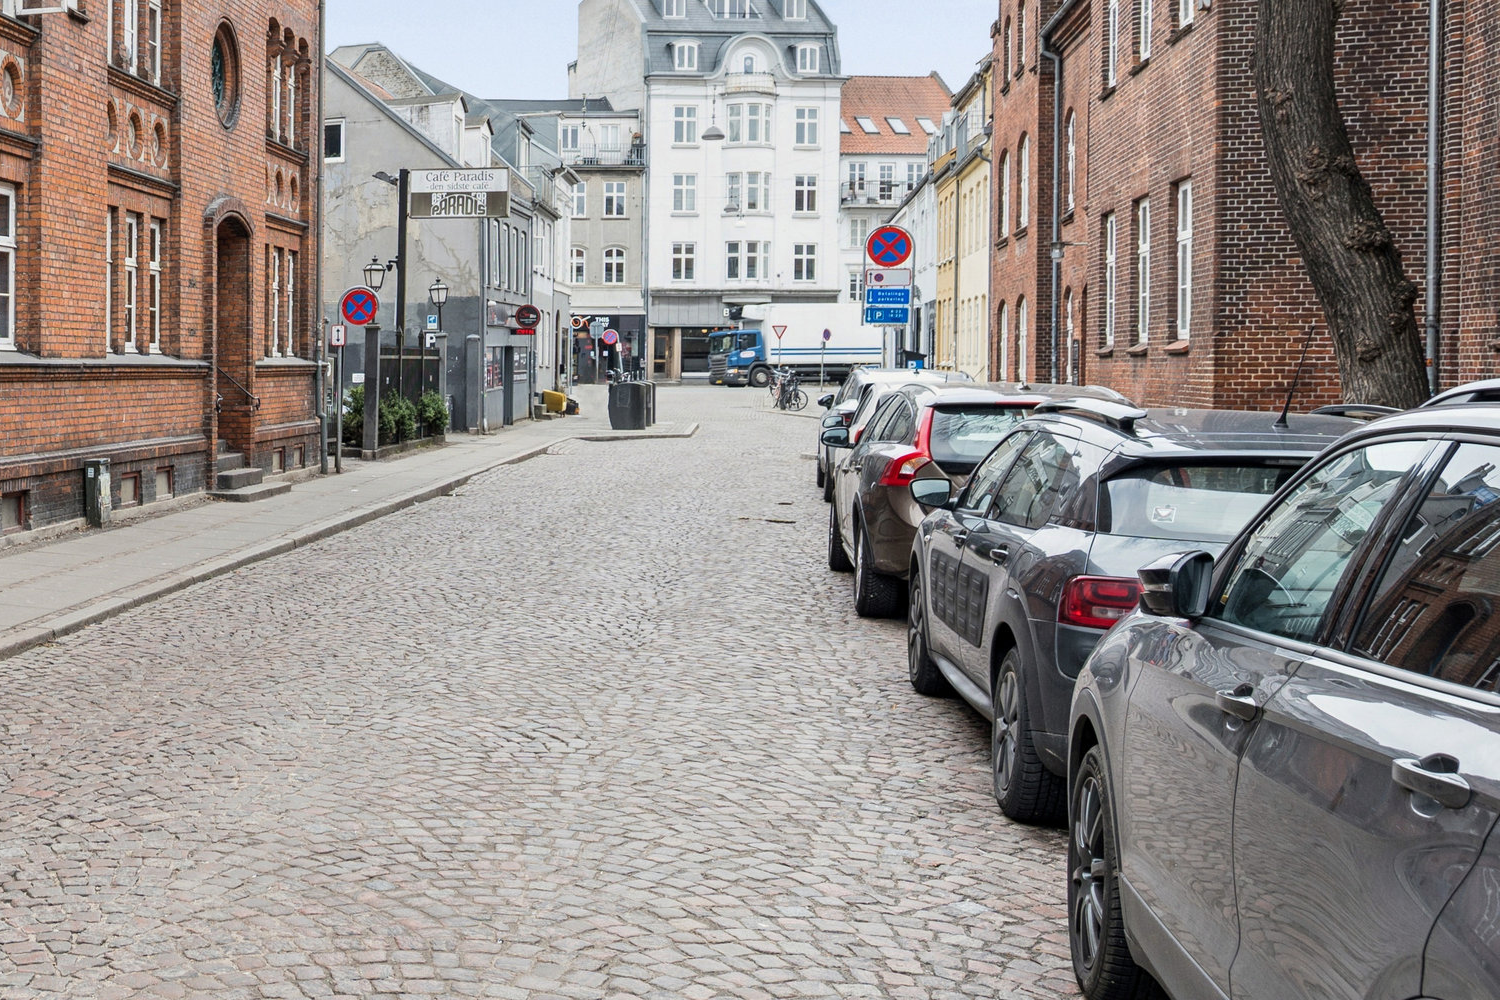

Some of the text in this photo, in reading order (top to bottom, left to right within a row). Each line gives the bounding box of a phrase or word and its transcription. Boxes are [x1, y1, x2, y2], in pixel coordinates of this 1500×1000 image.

[425, 170, 494, 182] Café Paradis
[447, 182, 469, 190] sidste
[431, 194, 487, 216] PARADIS
[876, 312, 883, 320] P
